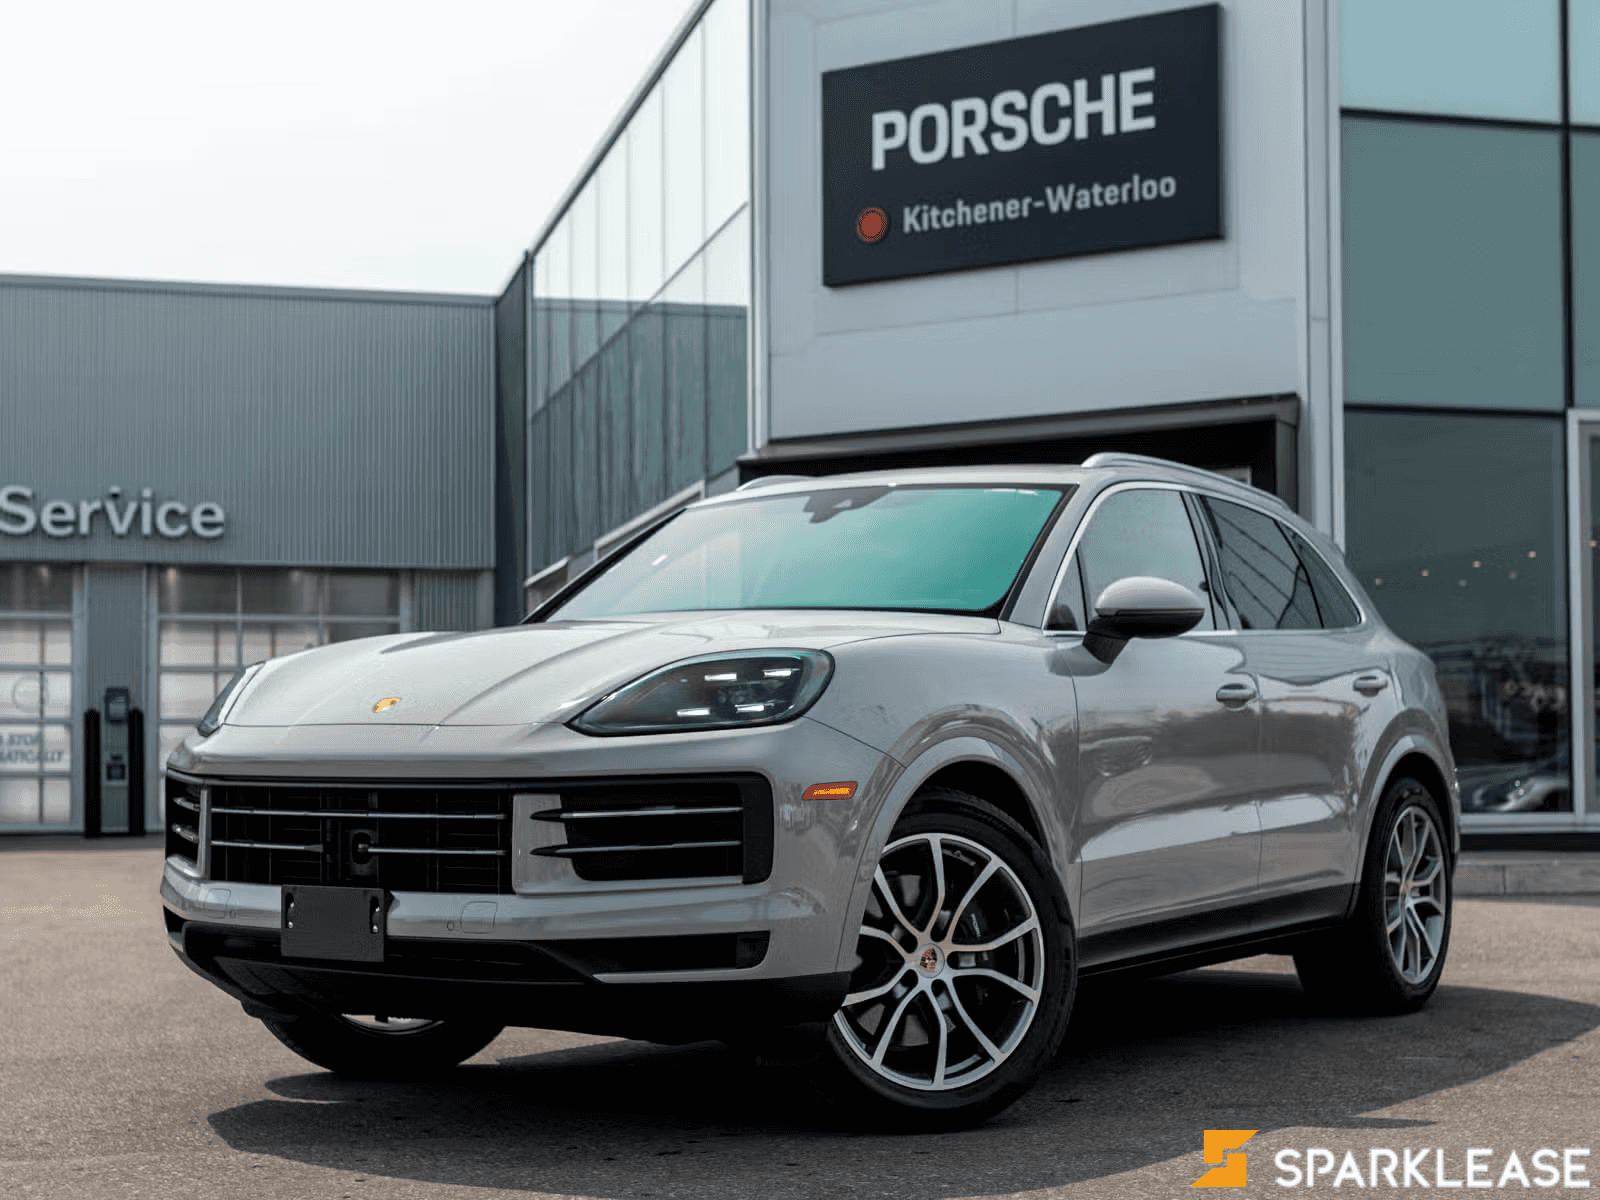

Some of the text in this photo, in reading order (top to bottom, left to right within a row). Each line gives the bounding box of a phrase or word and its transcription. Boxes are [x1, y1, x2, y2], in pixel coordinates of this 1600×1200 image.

[871, 66, 1156, 171] PORSCHE
[902, 173, 1177, 234] Kitchener-Waterloo
[0, 484, 225, 537] Service
